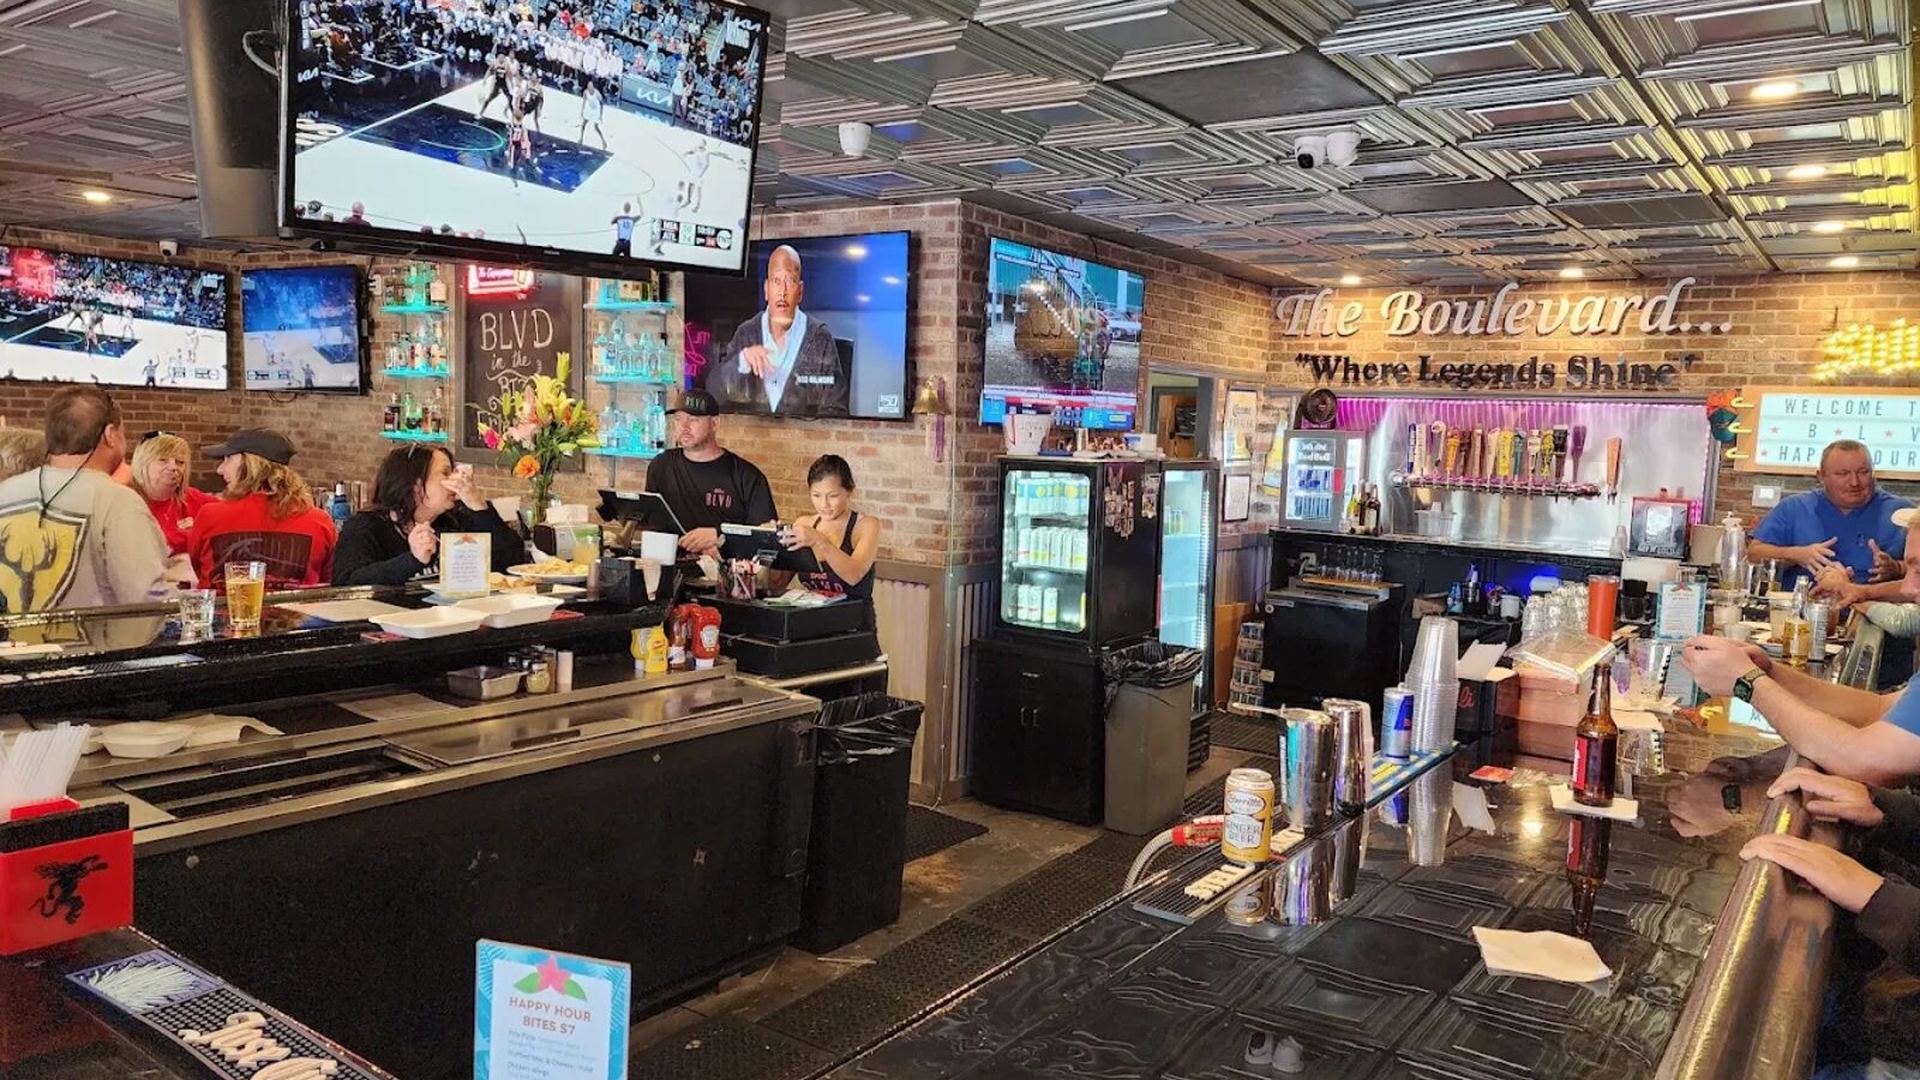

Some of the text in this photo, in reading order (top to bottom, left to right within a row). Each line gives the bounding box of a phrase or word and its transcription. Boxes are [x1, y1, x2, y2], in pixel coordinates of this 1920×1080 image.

[1276, 288, 1363, 337] The
[480, 308, 553, 351] BLVD
[491, 351, 532, 371] in the
[1418, 354, 1555, 389] Legends
[1785, 398, 1884, 416] WELCOME
[509, 996, 592, 1022] HAPPY HOUR
[523, 1015, 557, 1032] BITES
